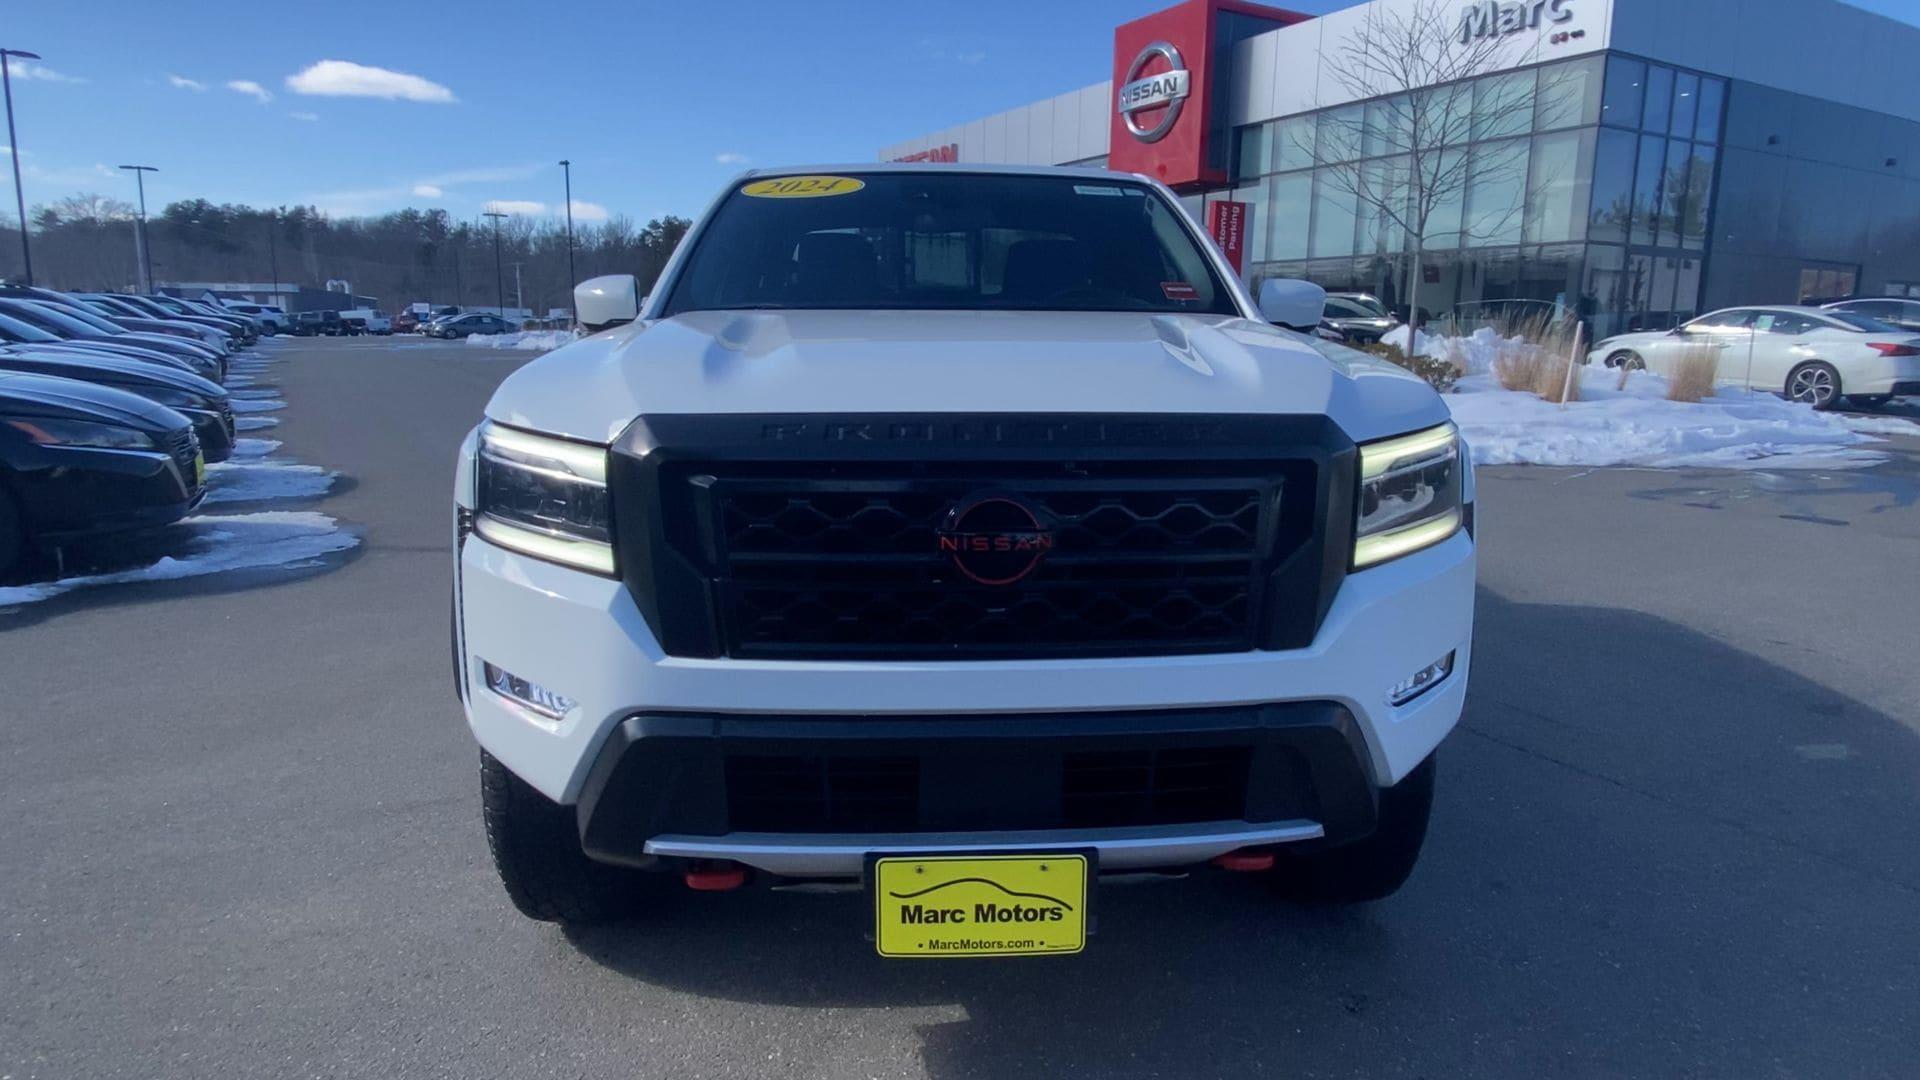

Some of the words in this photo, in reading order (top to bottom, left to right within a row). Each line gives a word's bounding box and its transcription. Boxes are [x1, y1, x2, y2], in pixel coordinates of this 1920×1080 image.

[1458, 0, 1573, 45] Marc
[1121, 77, 1178, 104] NISSAN
[755, 179, 842, 194] 2024
[1218, 205, 1228, 253] ustomer
[1229, 206, 1240, 250] Parking
[940, 535, 1053, 552] NISSAN
[901, 904, 966, 924] Marc
[974, 903, 1064, 923] Motors
[928, 939, 1035, 950] MarcMotors.com
